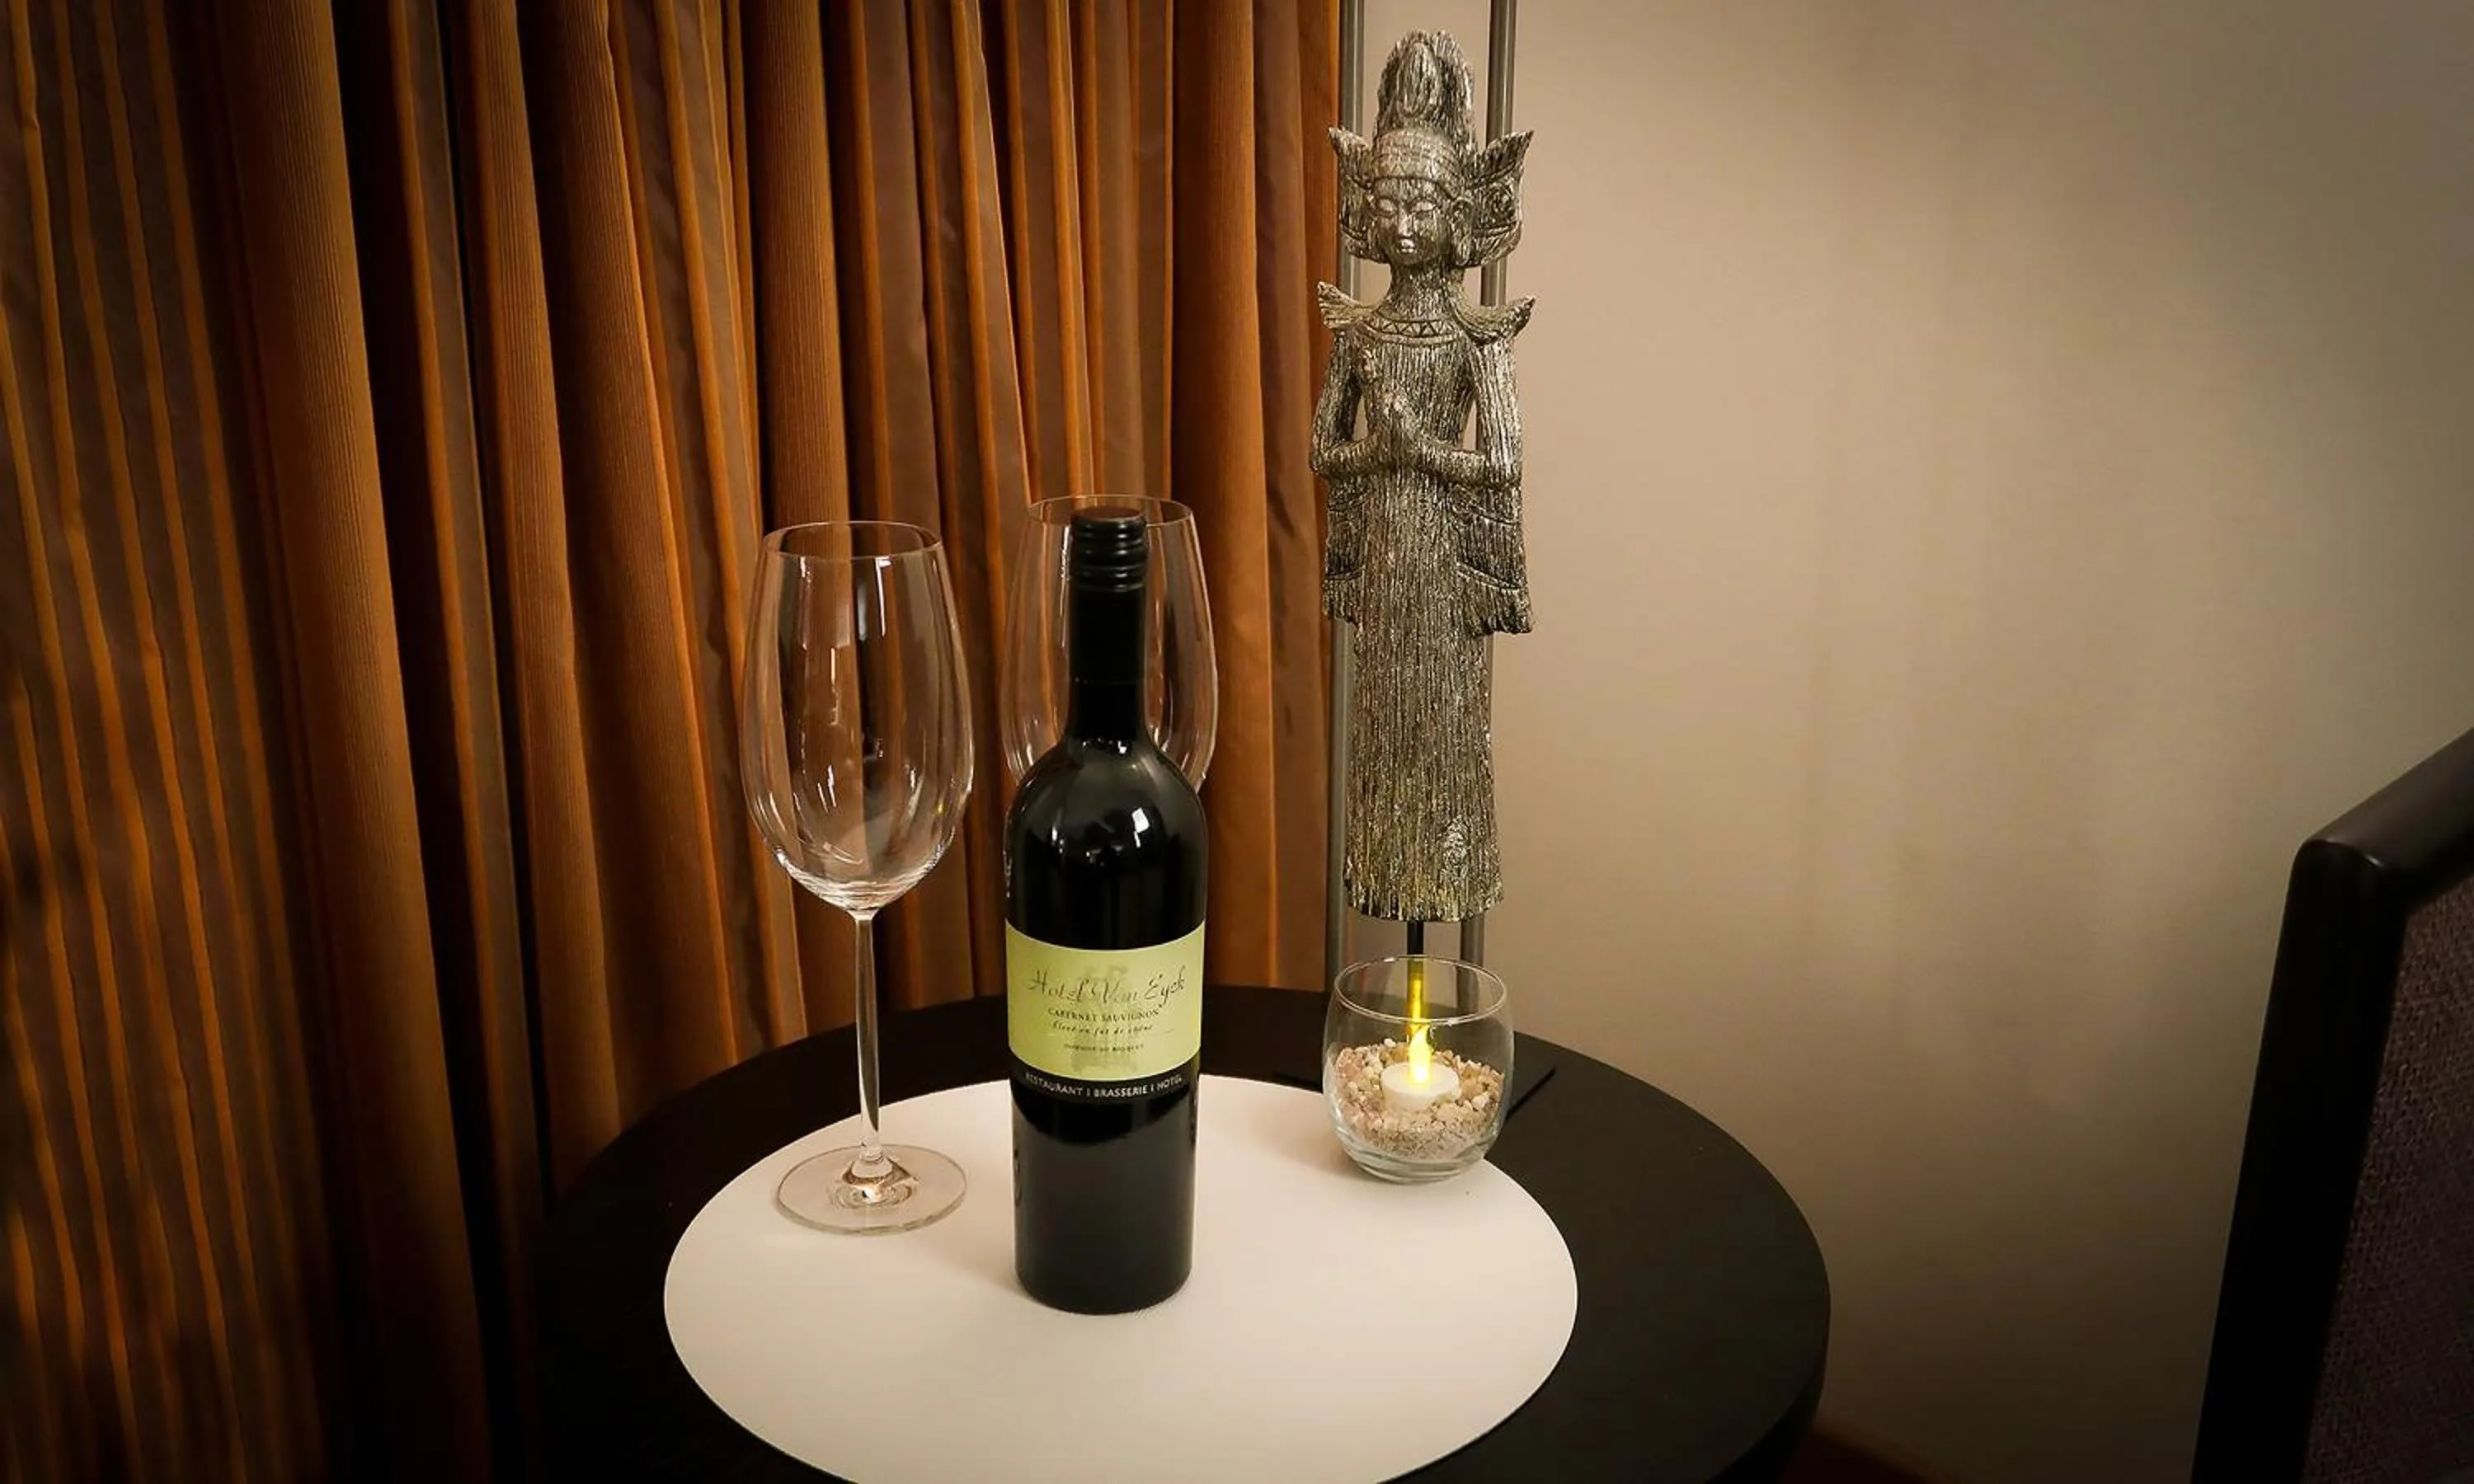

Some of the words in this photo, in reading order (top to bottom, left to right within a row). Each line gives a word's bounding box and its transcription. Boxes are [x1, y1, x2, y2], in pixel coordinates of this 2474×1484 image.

[1028, 969, 1089, 1003] Hotel
[1144, 964, 1186, 1008] Eyck
[1047, 1007, 1097, 1021] CABERNET
[1101, 1007, 1159, 1022] SAUVIGNON
[1025, 1072, 1083, 1097] RESTAURANT
[1094, 1084, 1148, 1098] BRASSERIE
[1156, 1073, 1183, 1092] HOTEL
